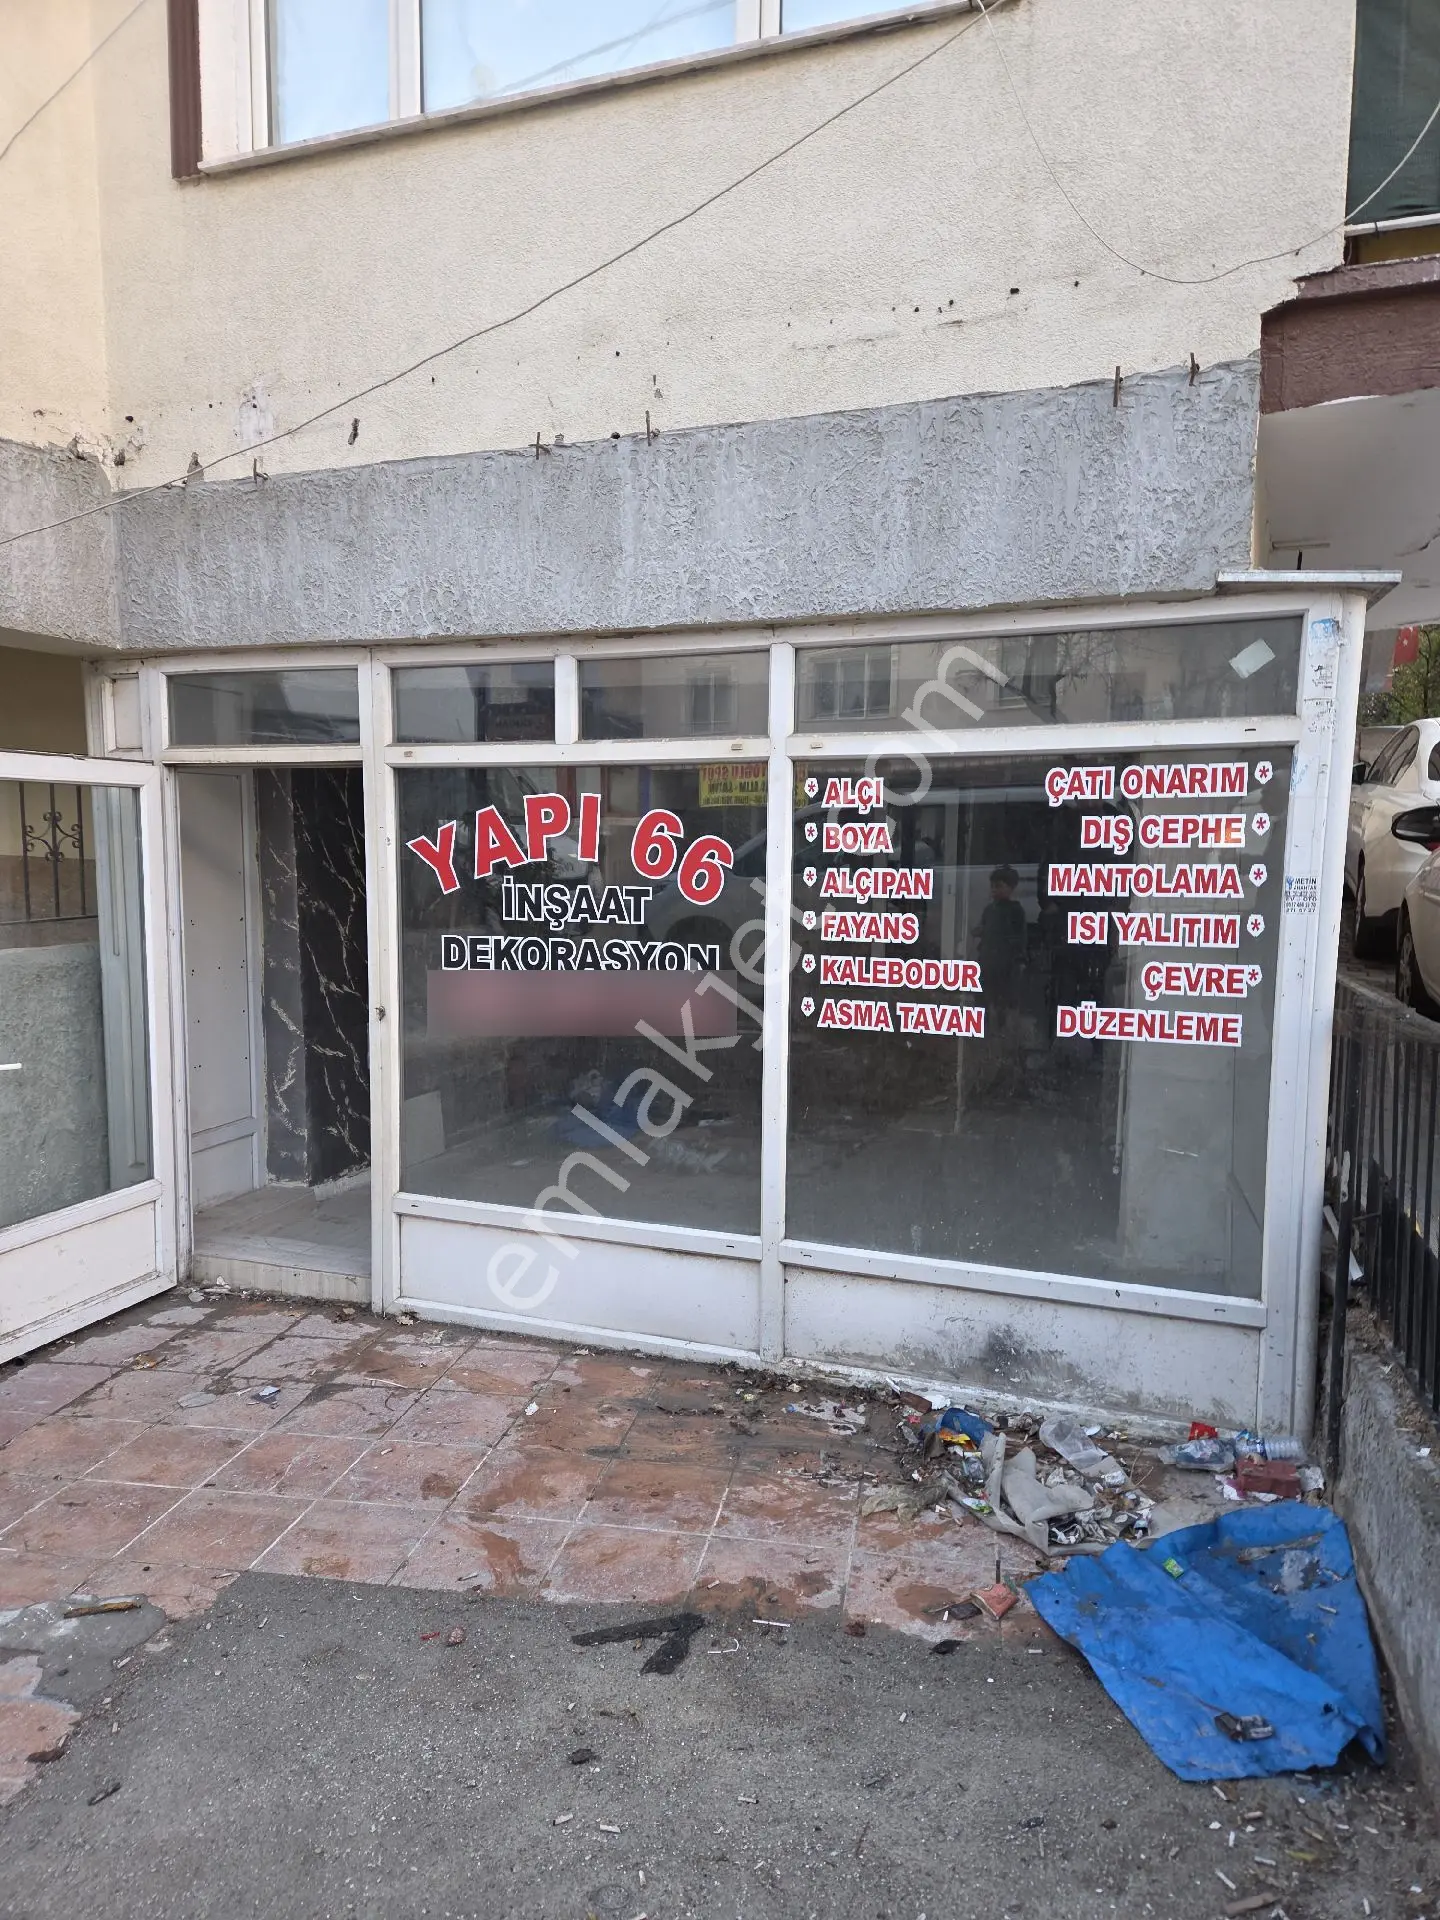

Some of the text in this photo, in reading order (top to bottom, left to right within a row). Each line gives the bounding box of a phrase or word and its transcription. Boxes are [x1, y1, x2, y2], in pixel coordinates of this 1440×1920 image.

[823, 778, 884, 813] ALÇI
[1046, 763, 1248, 806] ÇATI ONARIM
[406, 793, 734, 905] YAPI 66
[823, 823, 893, 852] BOYA
[1082, 814, 1246, 855] DIŞ CEPHE
[821, 868, 933, 903] ALÇIPAN
[1048, 864, 1243, 898] MANTOLAMA
[501, 876, 652, 931] İNŞAAT
[822, 912, 918, 943] FAYANS
[1068, 912, 1240, 947] ISI YALITIM
[441, 935, 720, 971] DEKORASYON
[821, 955, 982, 991] KALEBODUR
[1142, 962, 1247, 1000] ÇEVRE
[818, 1000, 985, 1038] ASMA TAVAN
[1057, 1002, 1242, 1046] DÜZENLEME
